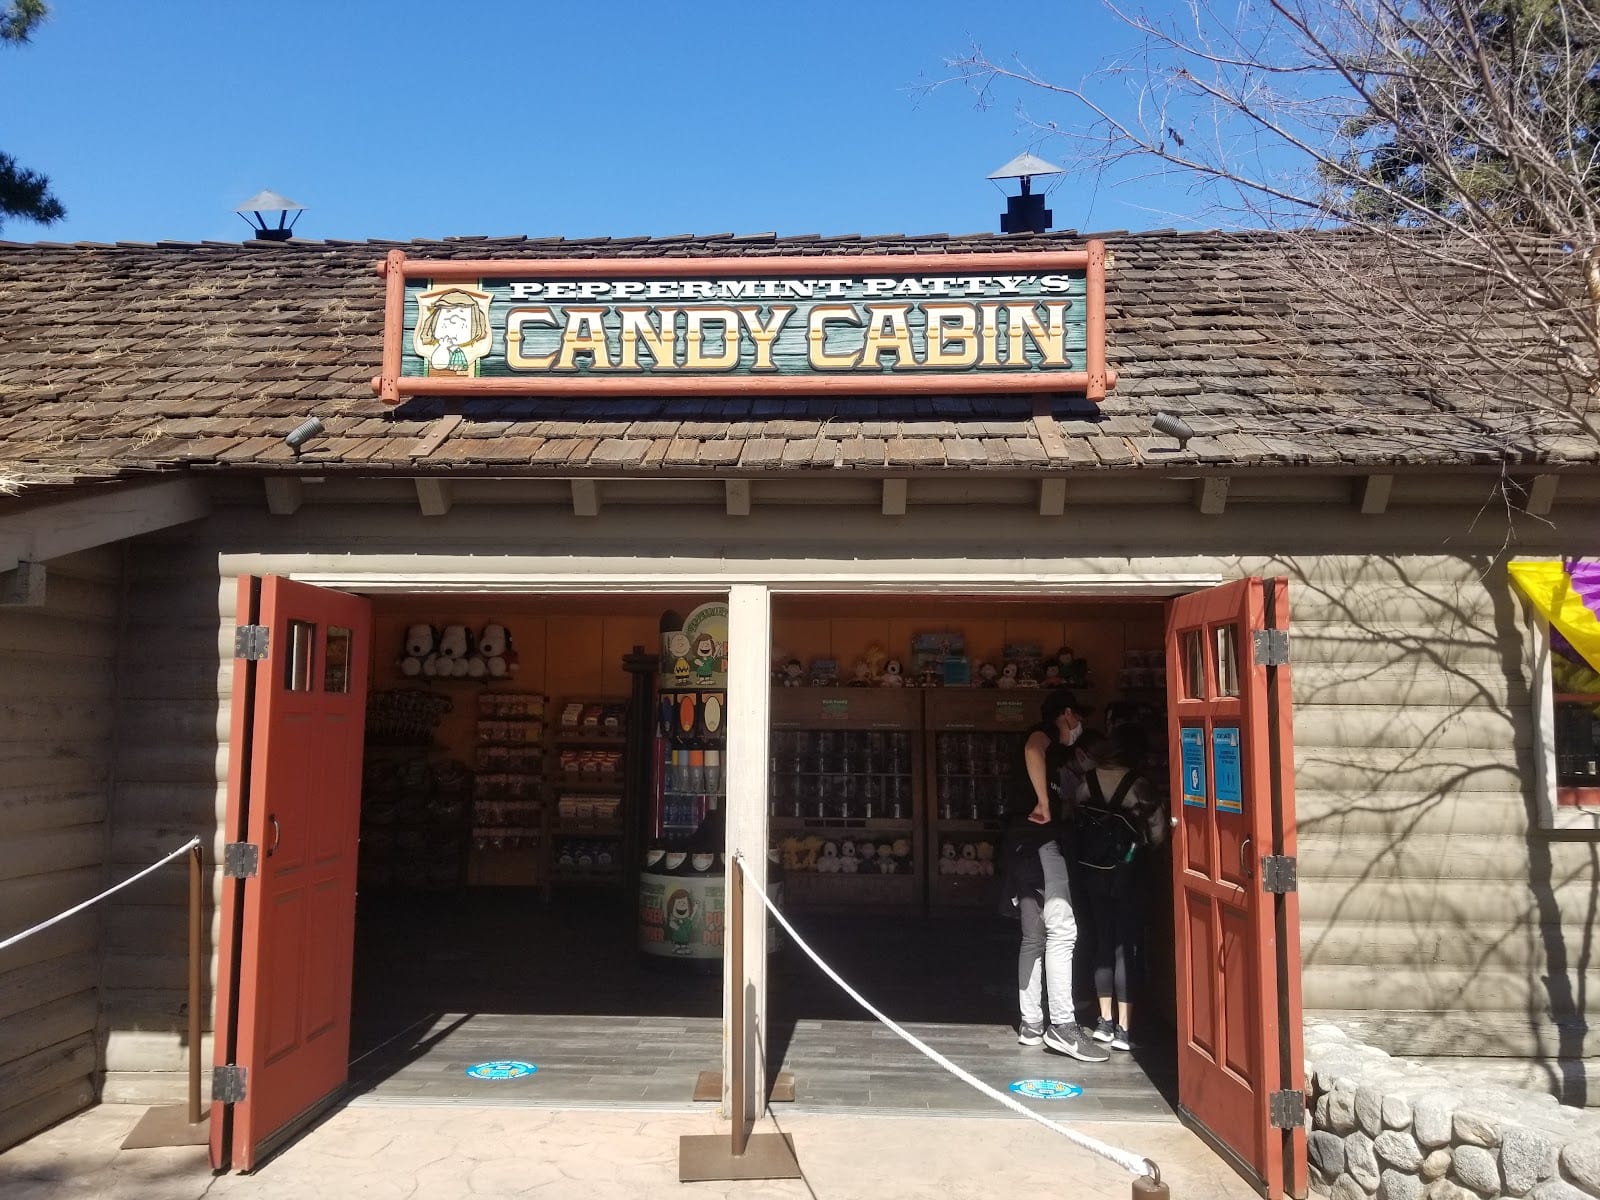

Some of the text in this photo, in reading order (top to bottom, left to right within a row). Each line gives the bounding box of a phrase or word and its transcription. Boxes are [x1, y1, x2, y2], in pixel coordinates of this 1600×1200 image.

[508, 274, 1070, 300] PEPPERMINT PATTY'S
[505, 299, 1073, 372] CANDY CABIN
